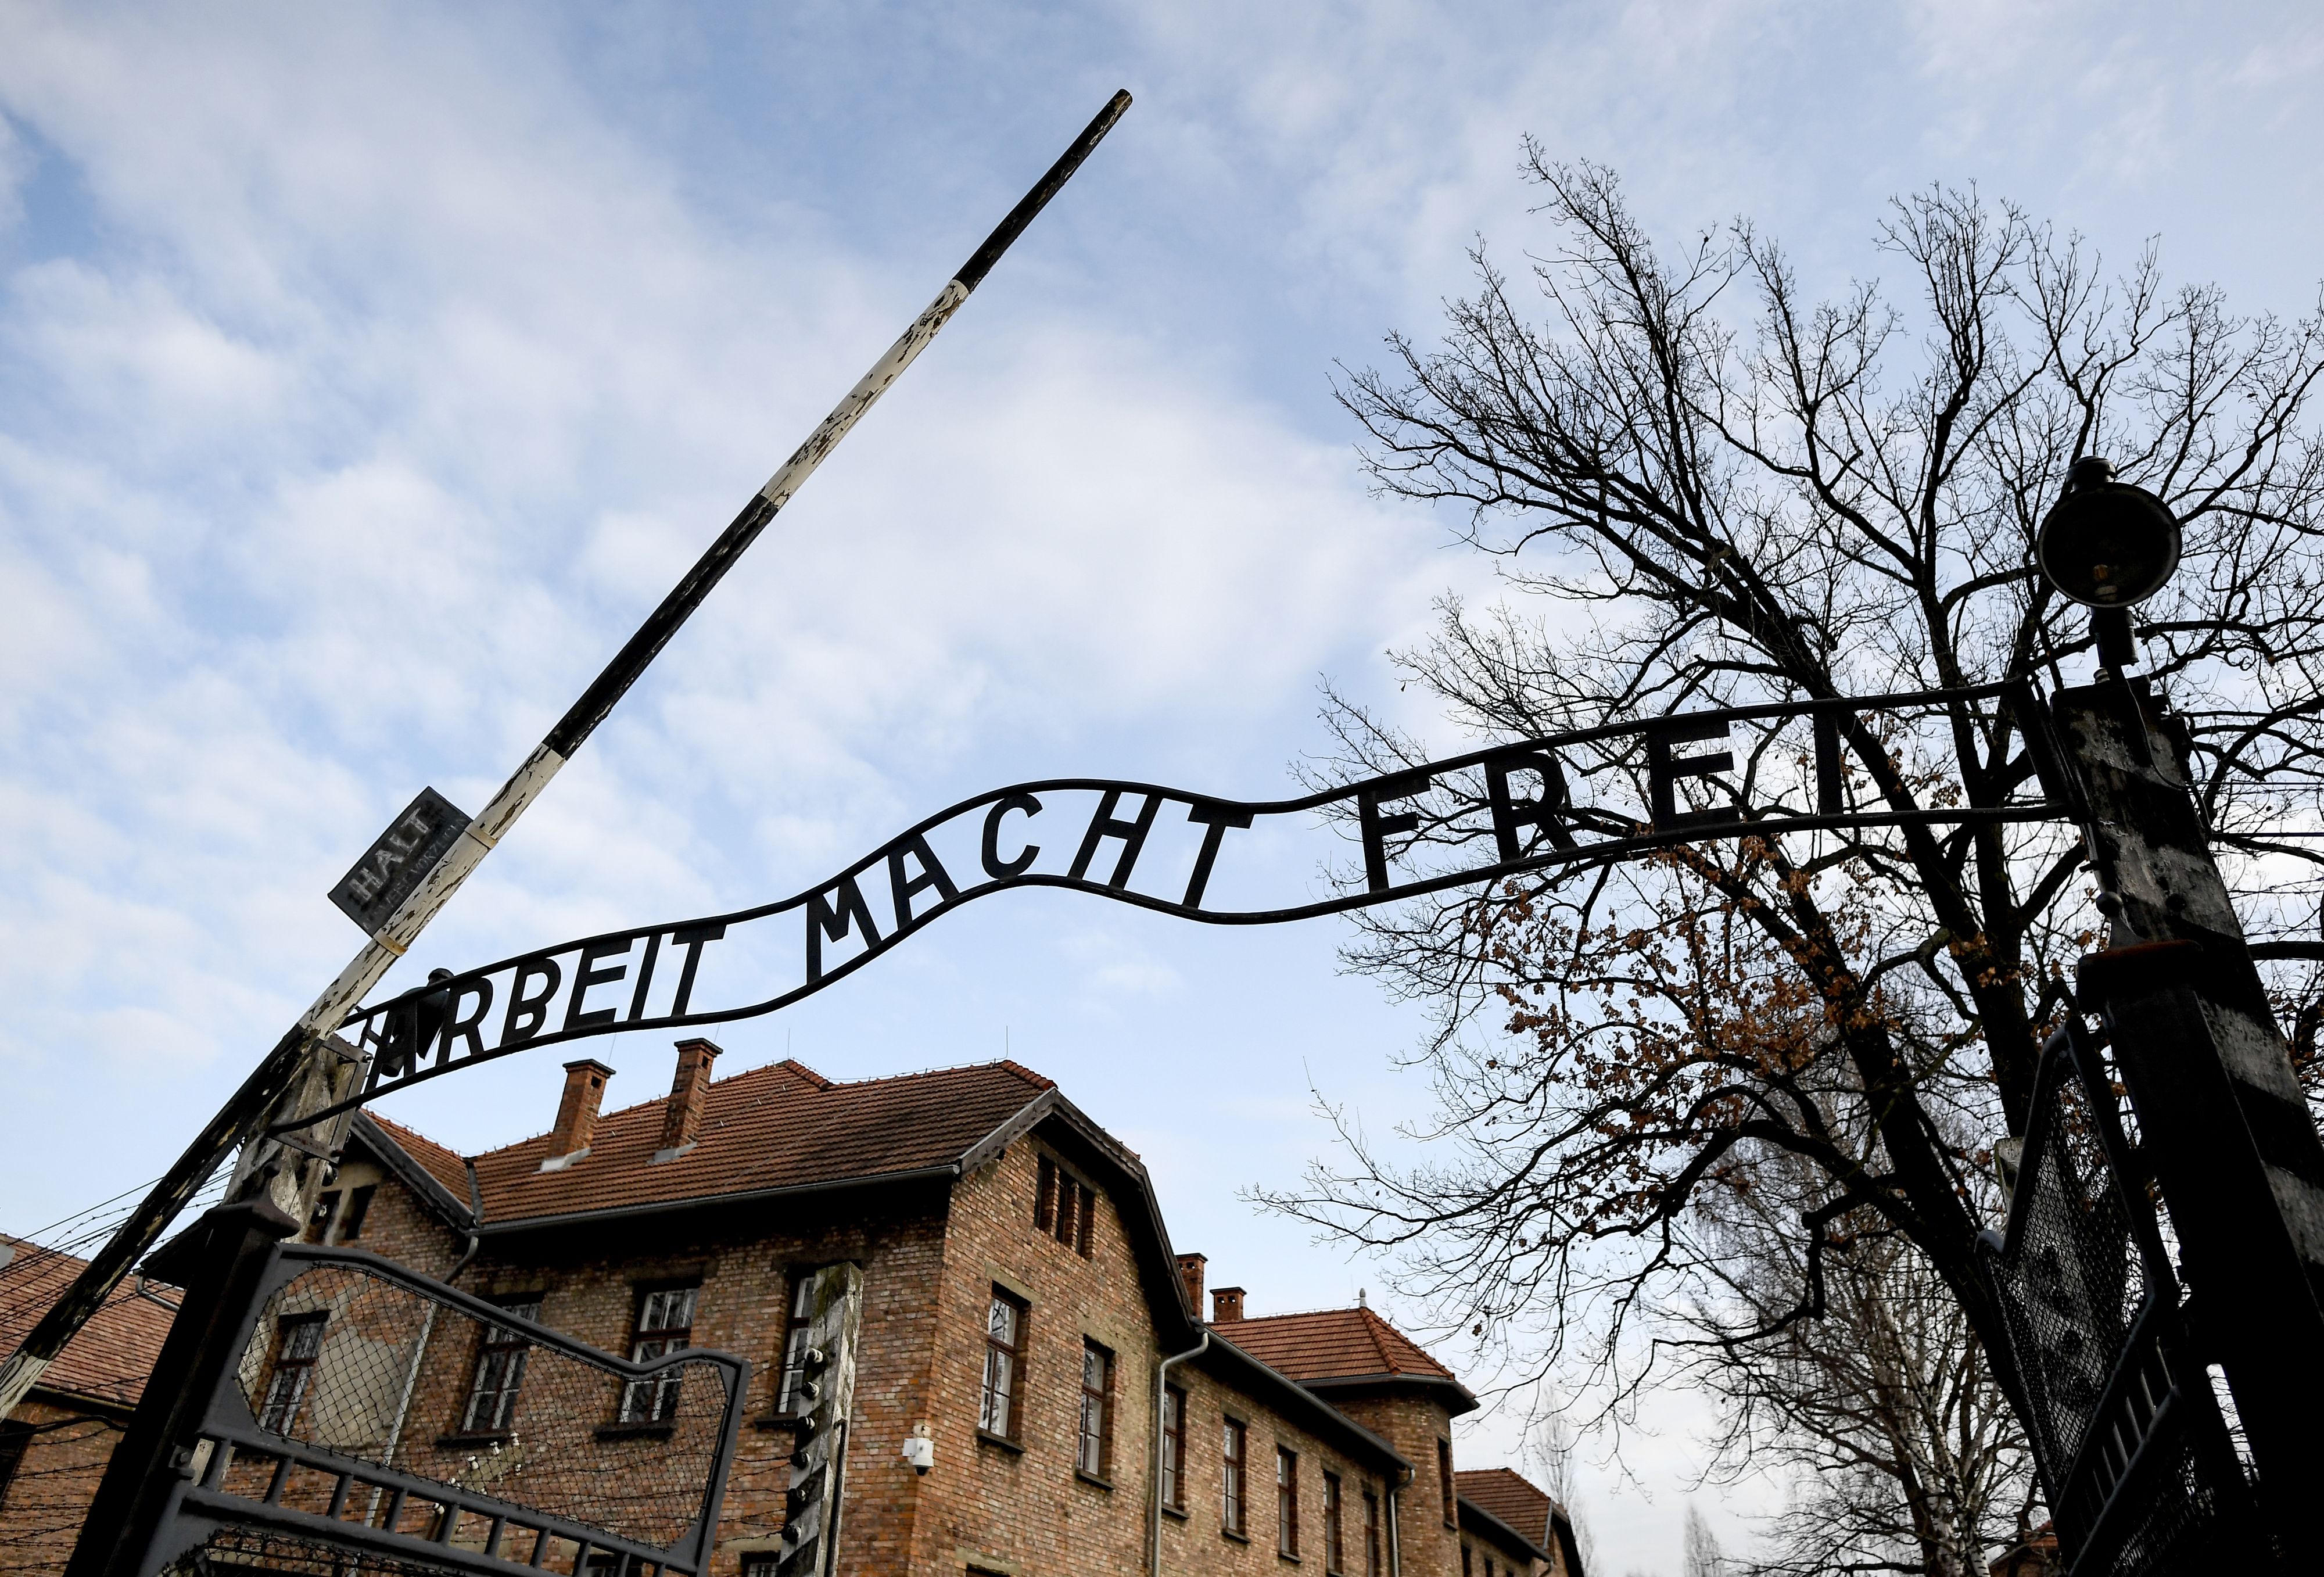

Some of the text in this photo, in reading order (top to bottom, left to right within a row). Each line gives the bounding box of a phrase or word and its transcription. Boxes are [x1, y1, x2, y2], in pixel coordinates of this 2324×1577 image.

[349, 807, 430, 902] HALT
[363, 711, 1843, 1095] ARBEIT MACHT FREI
